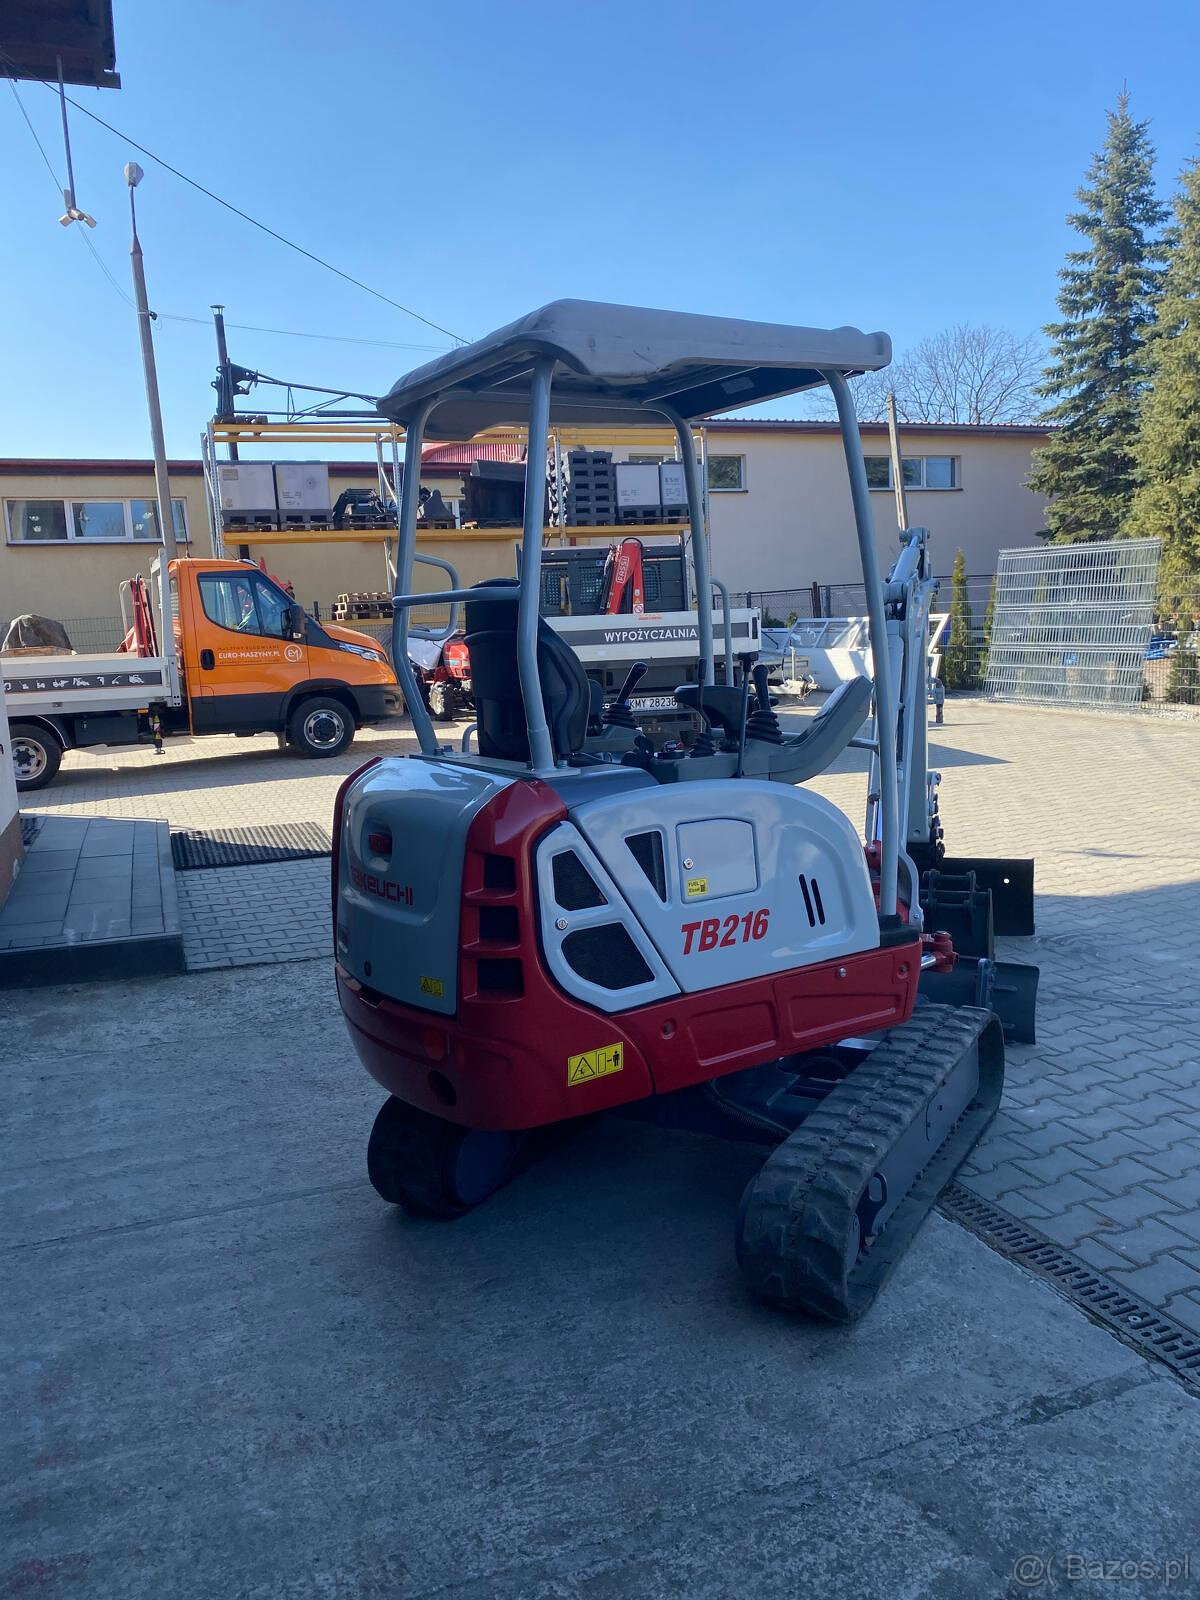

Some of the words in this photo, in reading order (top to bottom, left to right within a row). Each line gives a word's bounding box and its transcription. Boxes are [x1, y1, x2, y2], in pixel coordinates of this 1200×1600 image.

[617, 557, 628, 582] FASSI
[604, 628, 698, 642] WYPOŻYCZALNIA
[218, 650, 280, 659] EURO-MASZYNY.PL
[629, 699, 648, 708] KMY
[351, 868, 414, 906] AKEUCHI
[681, 908, 770, 955] TB216
